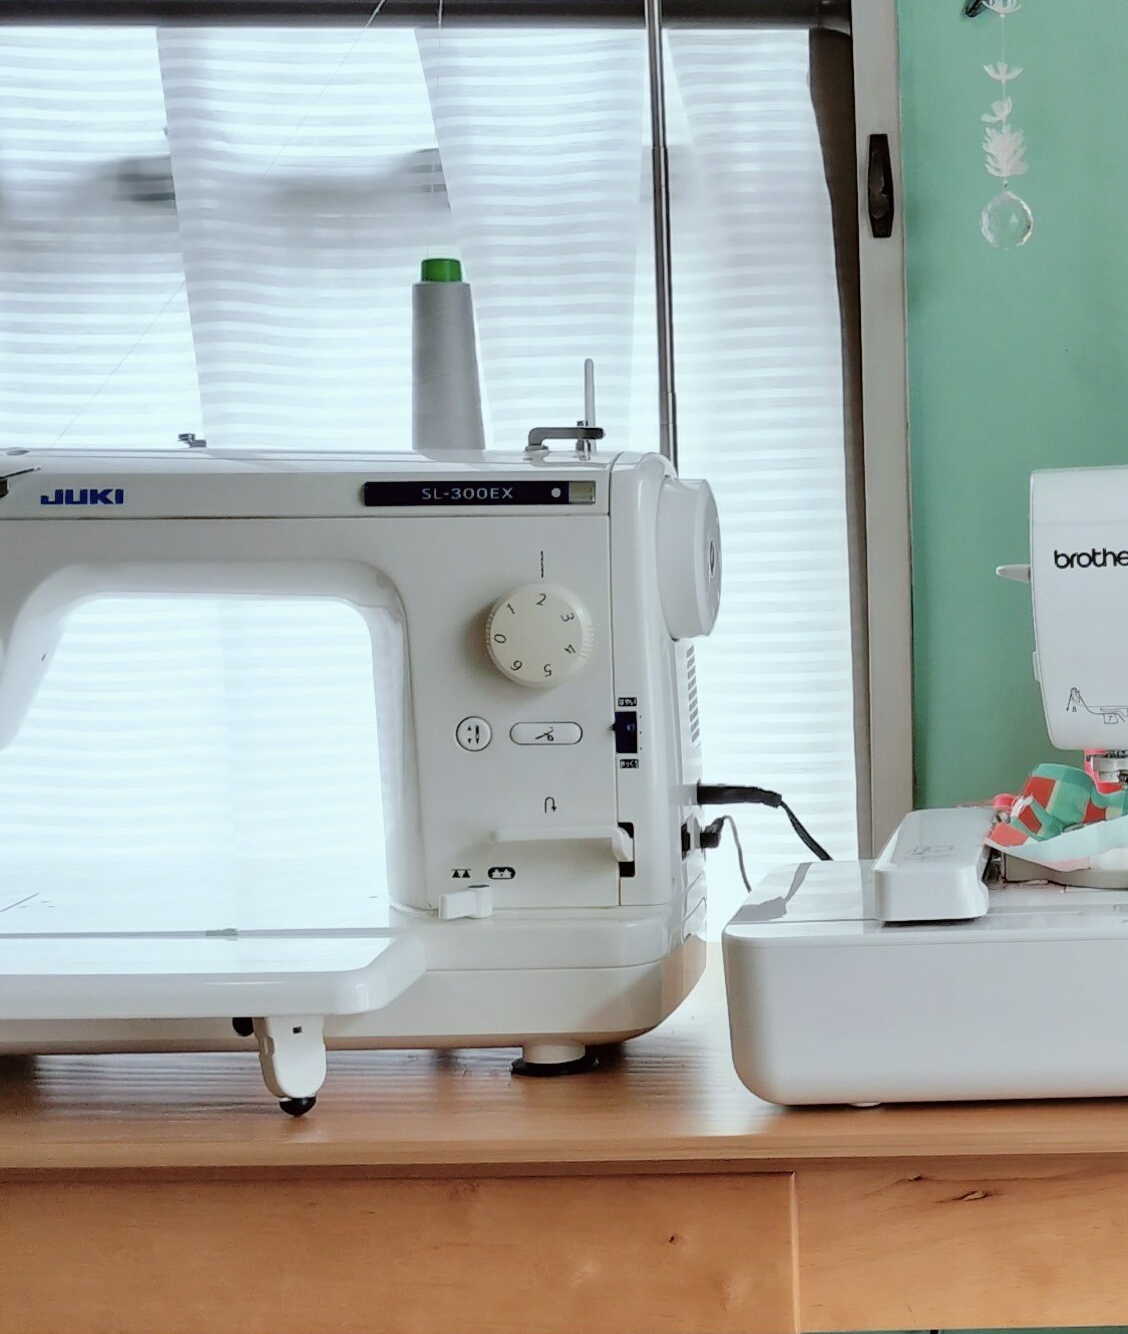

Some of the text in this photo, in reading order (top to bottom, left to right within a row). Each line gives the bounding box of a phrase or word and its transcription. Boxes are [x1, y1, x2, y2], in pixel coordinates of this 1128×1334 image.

[40, 487, 124, 506] JUKI
[421, 486, 514, 501] SL-300EX
[536, 593, 547, 606] 2
[506, 603, 515, 615] 1
[560, 612, 575, 622] 3
[493, 633, 507, 644] 0
[563, 644, 576, 654] 4
[510, 660, 523, 671] 6
[543, 663, 552, 678] 5
